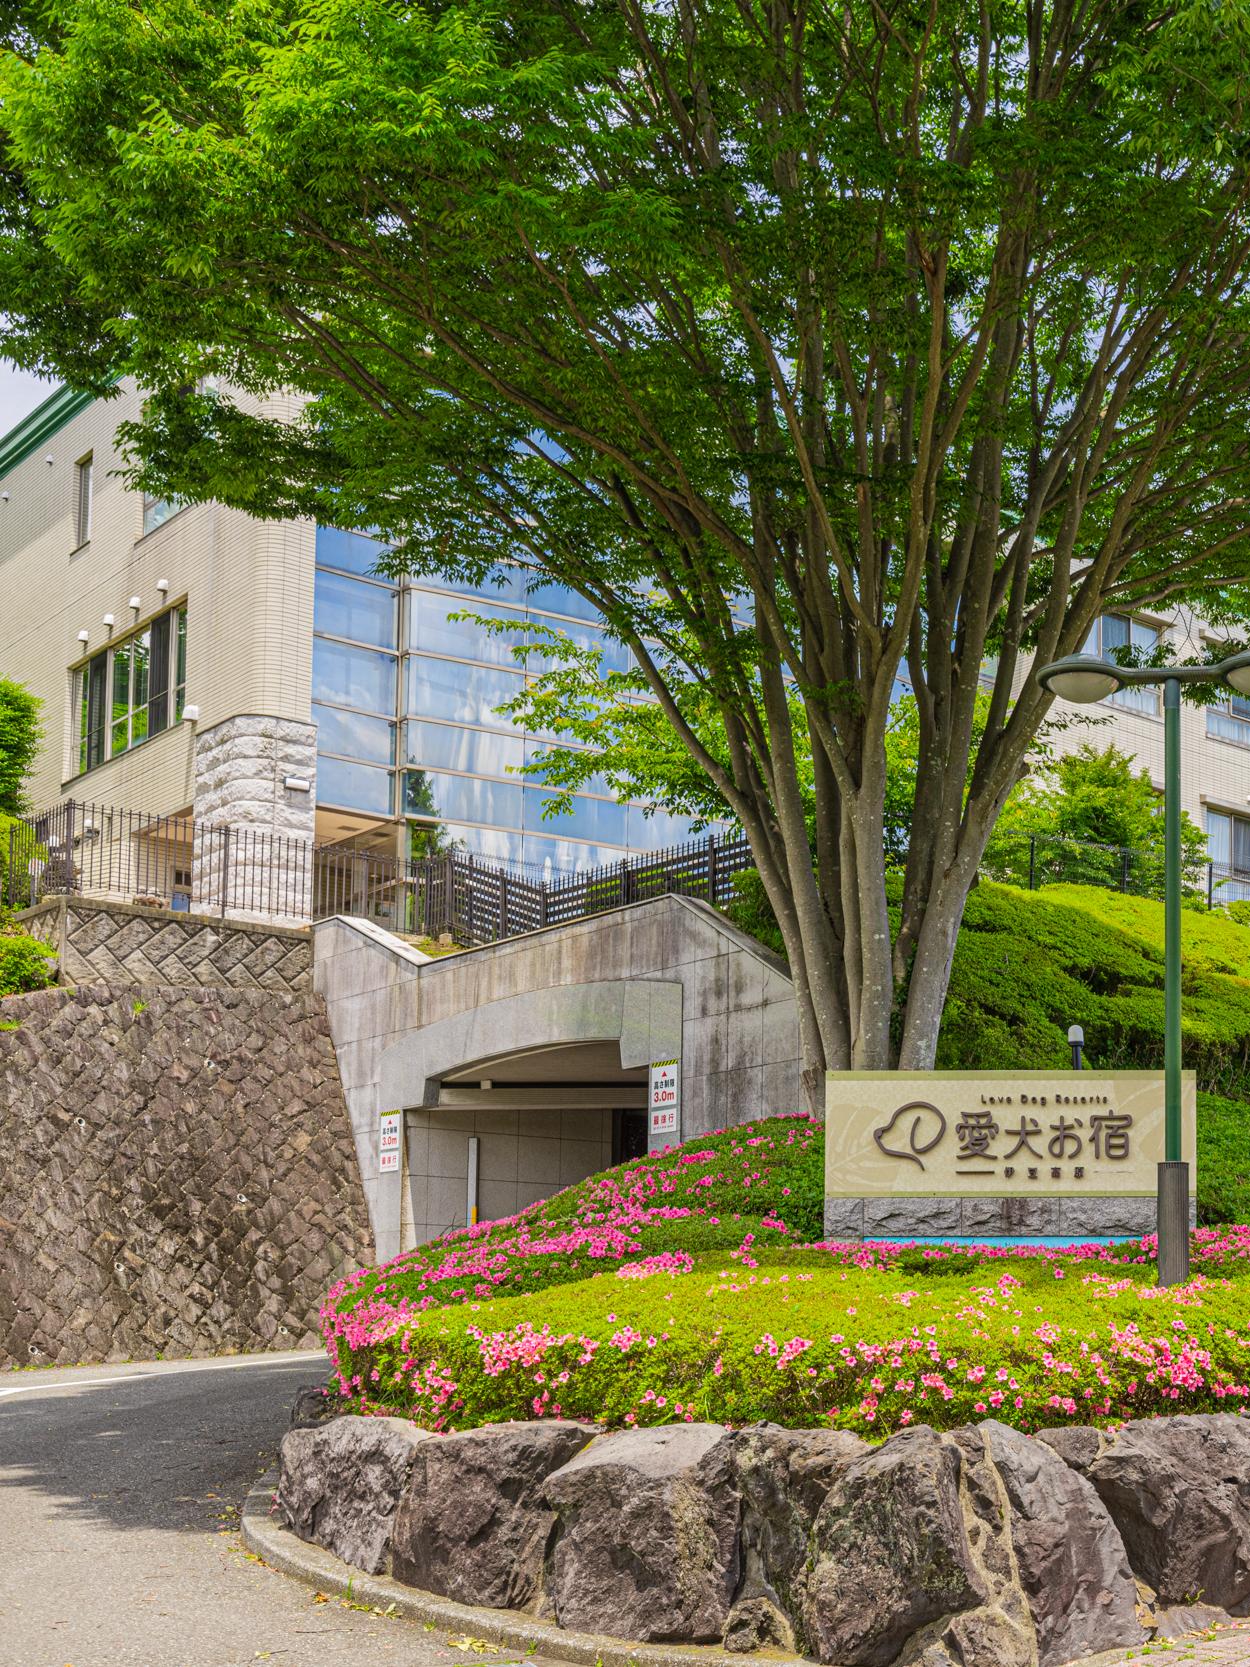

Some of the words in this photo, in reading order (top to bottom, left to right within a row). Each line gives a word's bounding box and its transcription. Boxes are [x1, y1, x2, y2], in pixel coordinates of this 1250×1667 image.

[654, 1078, 675, 1090] 高さ制限
[654, 1090, 675, 1104] 3.0m
[980, 1094, 1013, 1105] Love
[1020, 1094, 1047, 1106] Dog
[1055, 1094, 1109, 1105] Resorts
[382, 1136, 398, 1146] 3.0m
[955, 1109, 1134, 1161] 愛犬お宿
[1003, 1166, 1086, 1180] 伊豆高原
